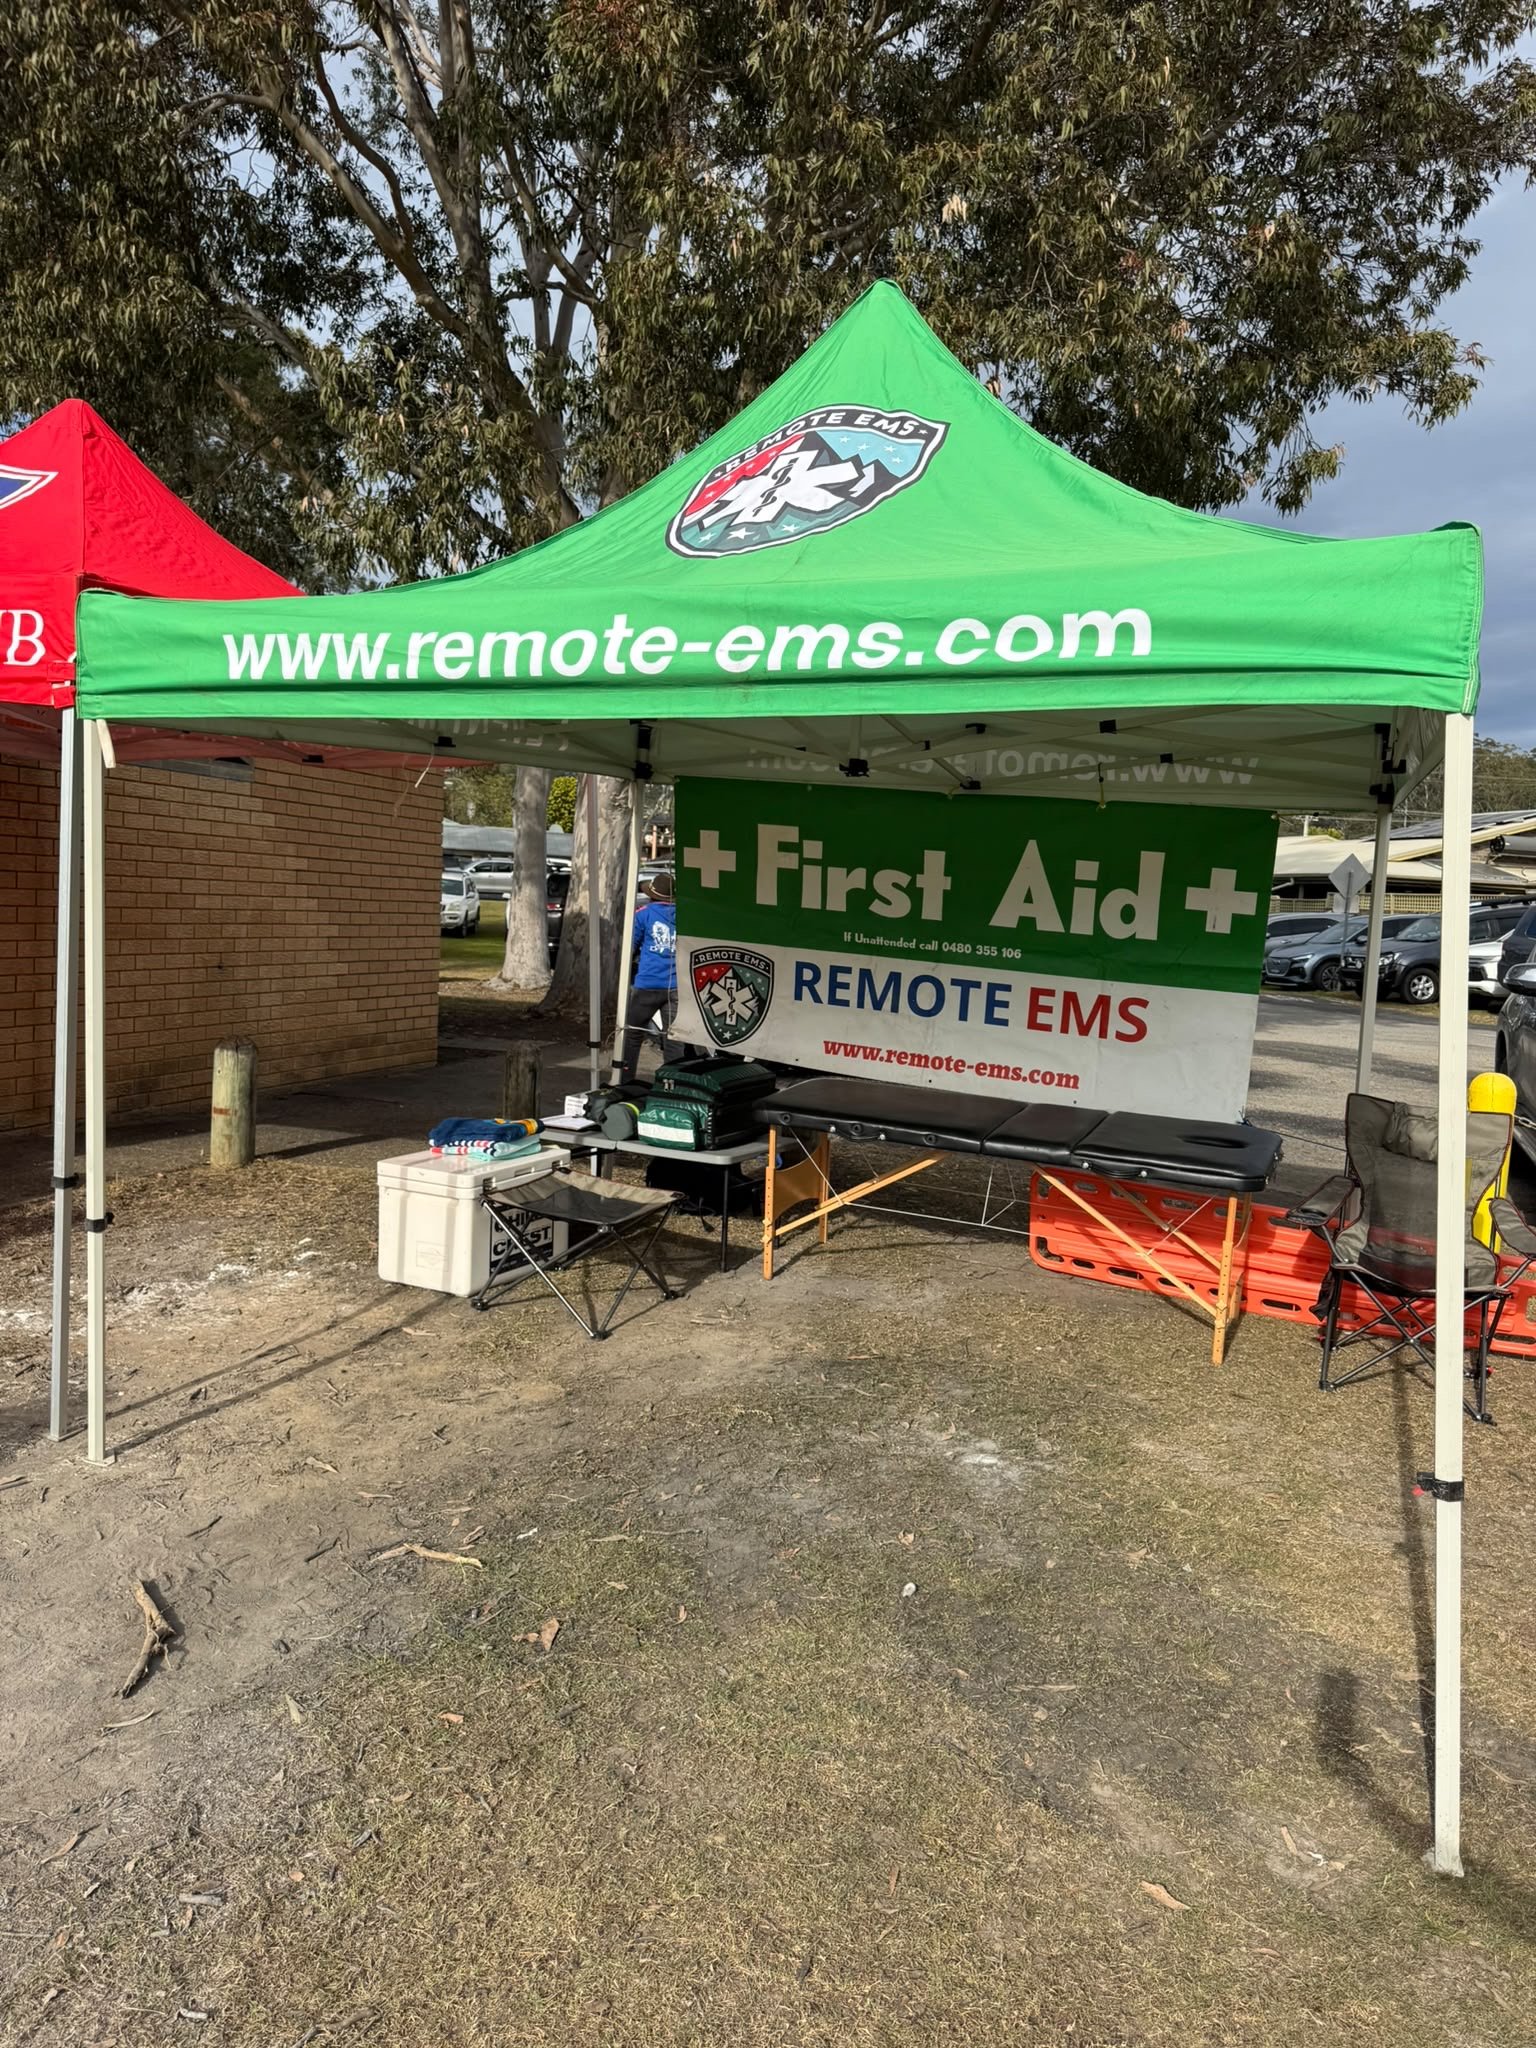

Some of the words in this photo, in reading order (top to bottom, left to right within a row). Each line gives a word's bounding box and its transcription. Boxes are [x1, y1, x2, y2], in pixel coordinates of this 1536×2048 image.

[724, 411, 846, 473] REMOTE
[853, 412, 920, 436] EMS
[0, 609, 46, 666] B
[222, 607, 1152, 681] www.remote-ems.com
[755, 823, 952, 922] First
[989, 839, 1166, 941] Aid
[698, 951, 742, 963] REMOTE
[743, 955, 766, 970] EMS
[843, 931, 852, 943] If
[854, 932, 917, 950] Unattended
[919, 939, 939, 951] call
[942, 941, 972, 955] 0480
[975, 945, 998, 957] 355
[1001, 947, 1022, 960] 106
[793, 960, 1012, 1028] REMOTE
[1026, 986, 1150, 1044] EMS
[822, 1038, 1080, 1090] www.remote-ems.com
